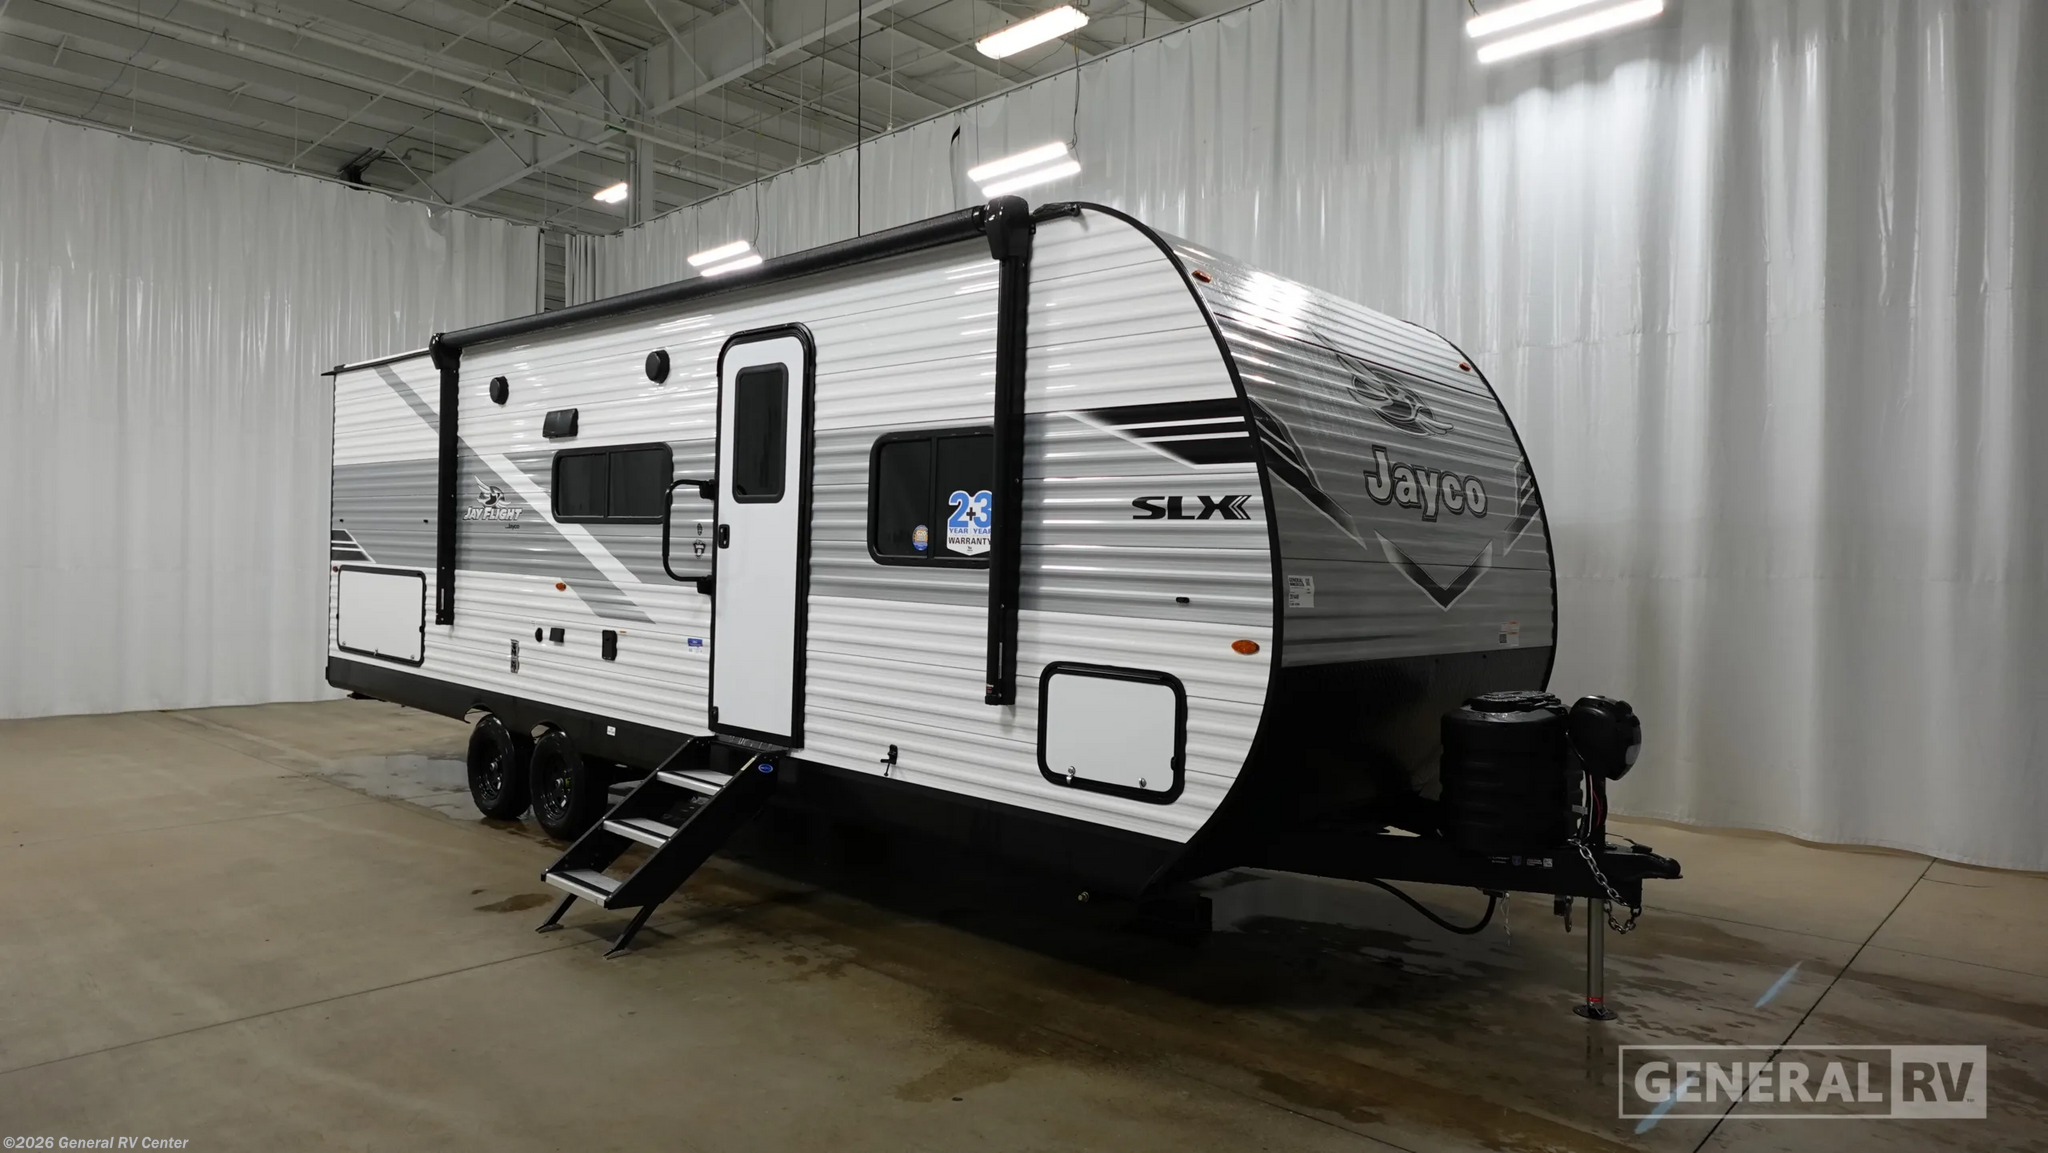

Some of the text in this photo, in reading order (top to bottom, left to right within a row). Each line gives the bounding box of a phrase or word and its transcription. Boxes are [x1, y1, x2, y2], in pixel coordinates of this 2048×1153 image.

[1363, 444, 1488, 523] Jayco
[462, 507, 522, 520] JAY FLIGHT
[1131, 494, 1252, 520] SLX
